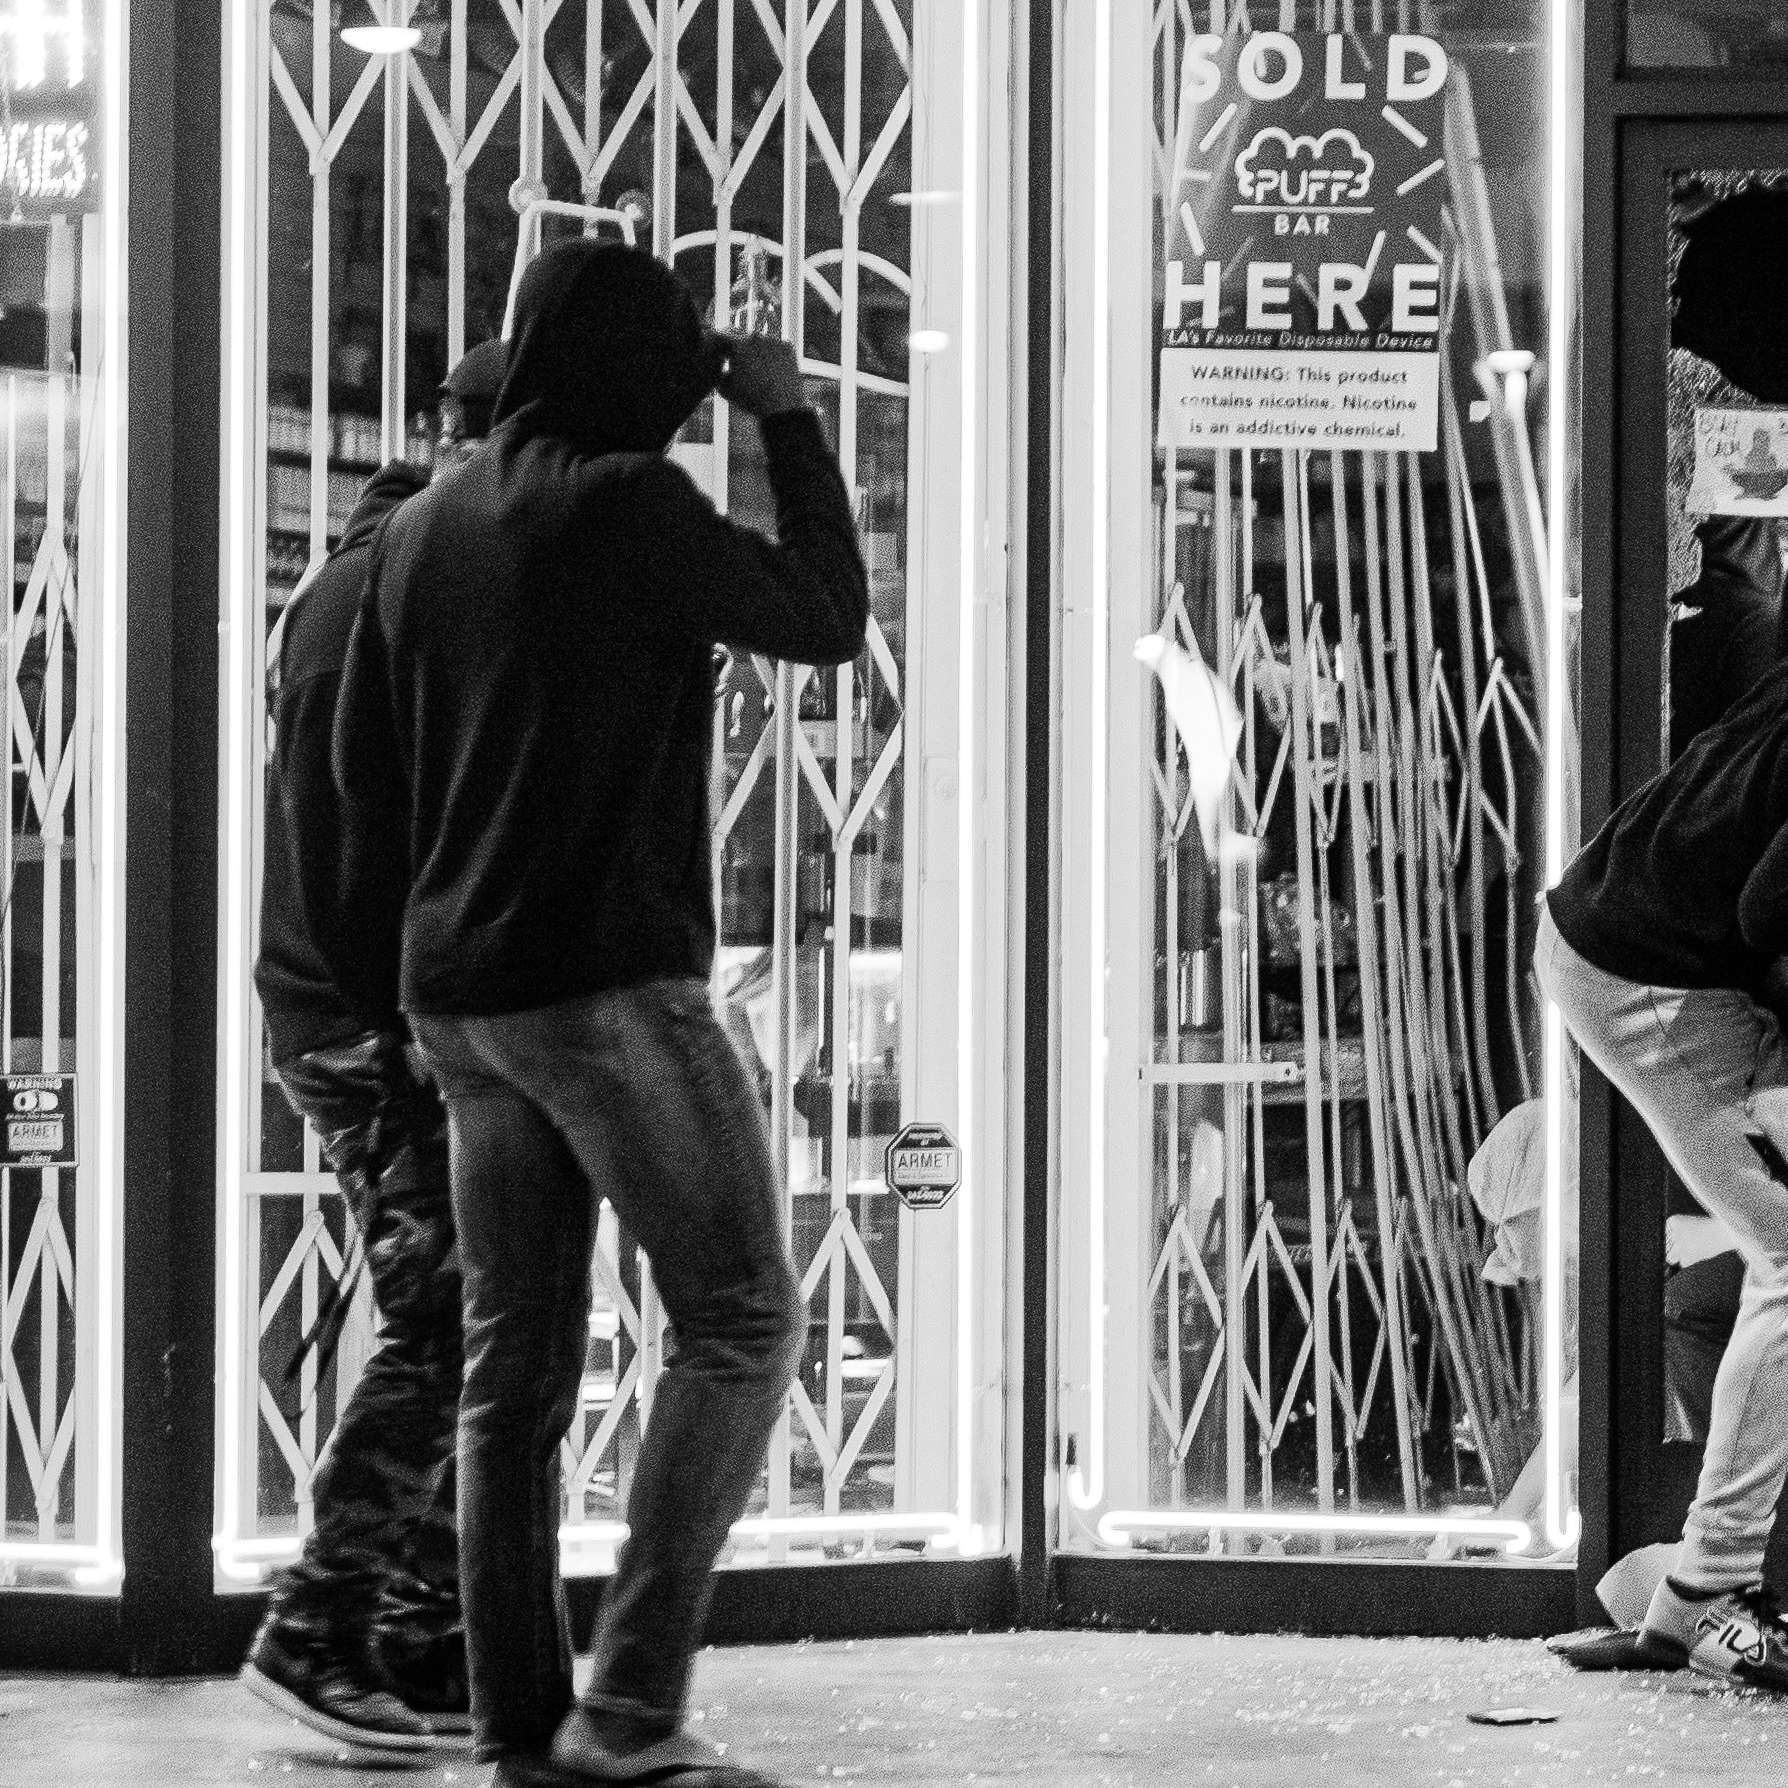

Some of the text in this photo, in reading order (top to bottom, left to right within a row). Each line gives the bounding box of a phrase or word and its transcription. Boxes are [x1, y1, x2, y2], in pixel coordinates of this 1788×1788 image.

[1180, 31, 1449, 102] SOLD
[1255, 169, 1355, 203] PUFF
[1274, 213, 1330, 236] BAR
[1163, 260, 1440, 333] HERE
[1206, 330, 1273, 345] Favorite
[1279, 332, 1370, 349] Disposable
[1375, 333, 1433, 348] Device
[1191, 365, 1408, 386] WARNING: This product
[1180, 392, 1253, 408] contains
[1342, 394, 1417, 410] Nicotine
[1190, 419, 1406, 437] is an addictive chemical.
[898, 1152, 953, 1168] ARMET
